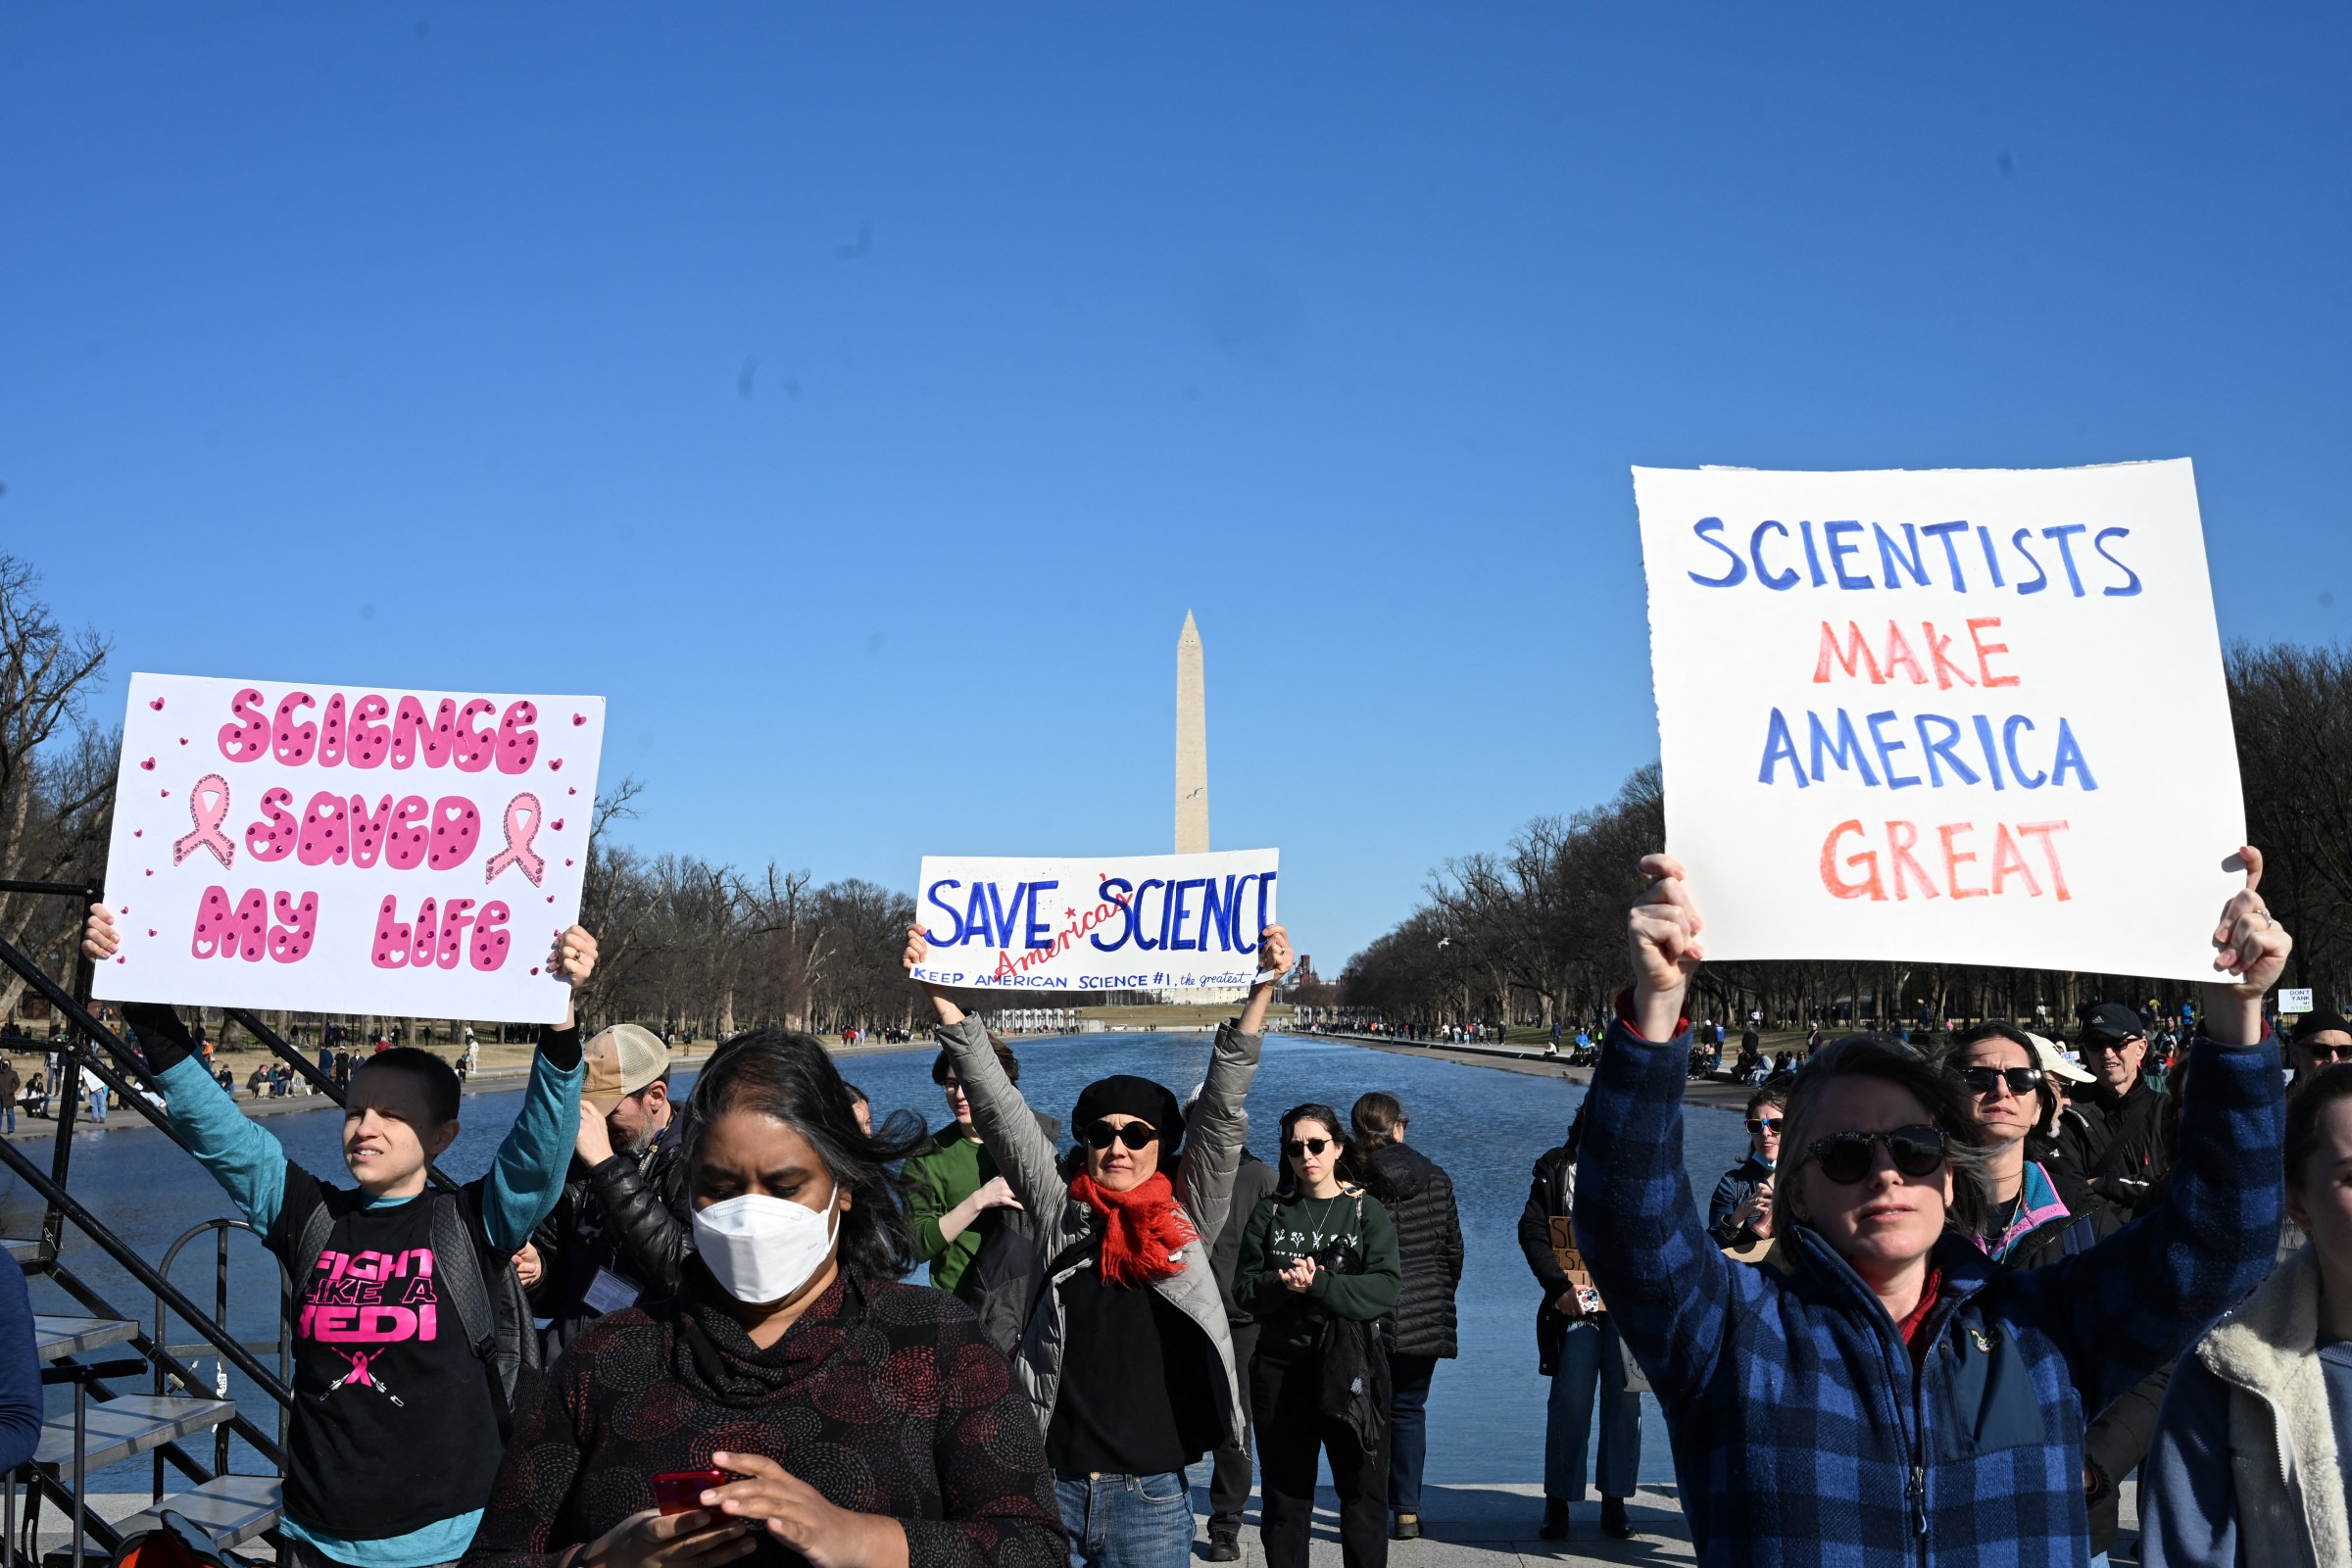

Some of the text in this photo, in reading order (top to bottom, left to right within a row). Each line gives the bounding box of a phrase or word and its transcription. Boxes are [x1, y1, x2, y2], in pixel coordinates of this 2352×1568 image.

[1688, 516, 2143, 598] SCIENTISTS
[1813, 616, 2021, 691] MAKE
[1758, 708, 2098, 792] AMERICA
[1819, 819, 2072, 902] GREAT
[924, 879, 1058, 949] SAVE
[913, 967, 964, 983] KEEP
[975, 974, 1068, 988] AMERICAN
[1078, 974, 1148, 989] SCIENCE
[1180, 973, 1196, 986] the
[316, 1248, 435, 1282] FIGHT
[401, 1276, 438, 1304] A
[297, 1304, 437, 1343] JEDI
